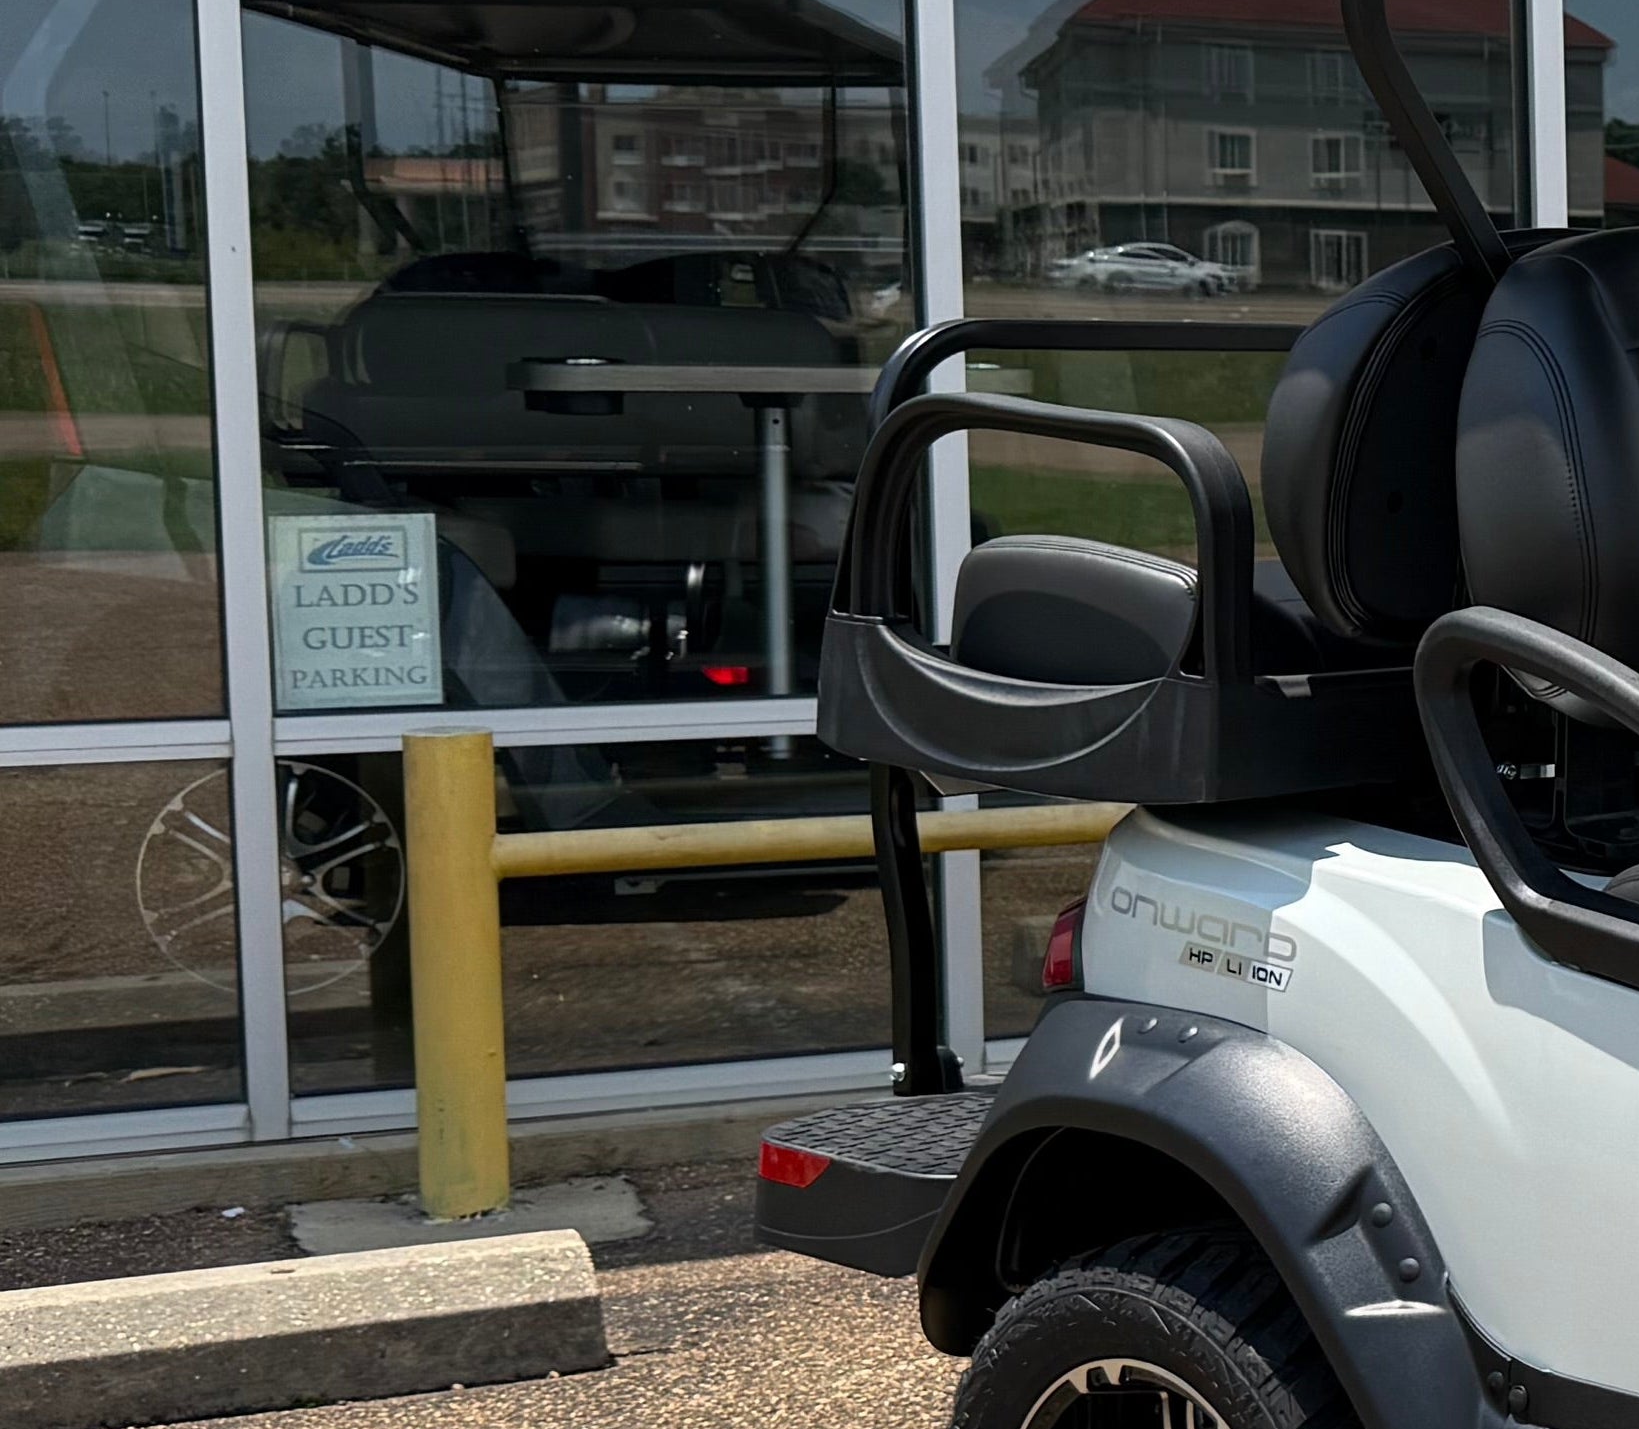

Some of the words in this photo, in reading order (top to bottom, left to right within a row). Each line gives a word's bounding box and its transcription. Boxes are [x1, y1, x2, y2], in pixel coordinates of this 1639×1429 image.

[294, 581, 419, 608] LADD'S
[302, 624, 414, 650] GUEST
[290, 666, 428, 689] PARKING
[1189, 947, 1213, 966] HP
[1226, 958, 1242, 976] LI
[1252, 965, 1283, 986] ION
